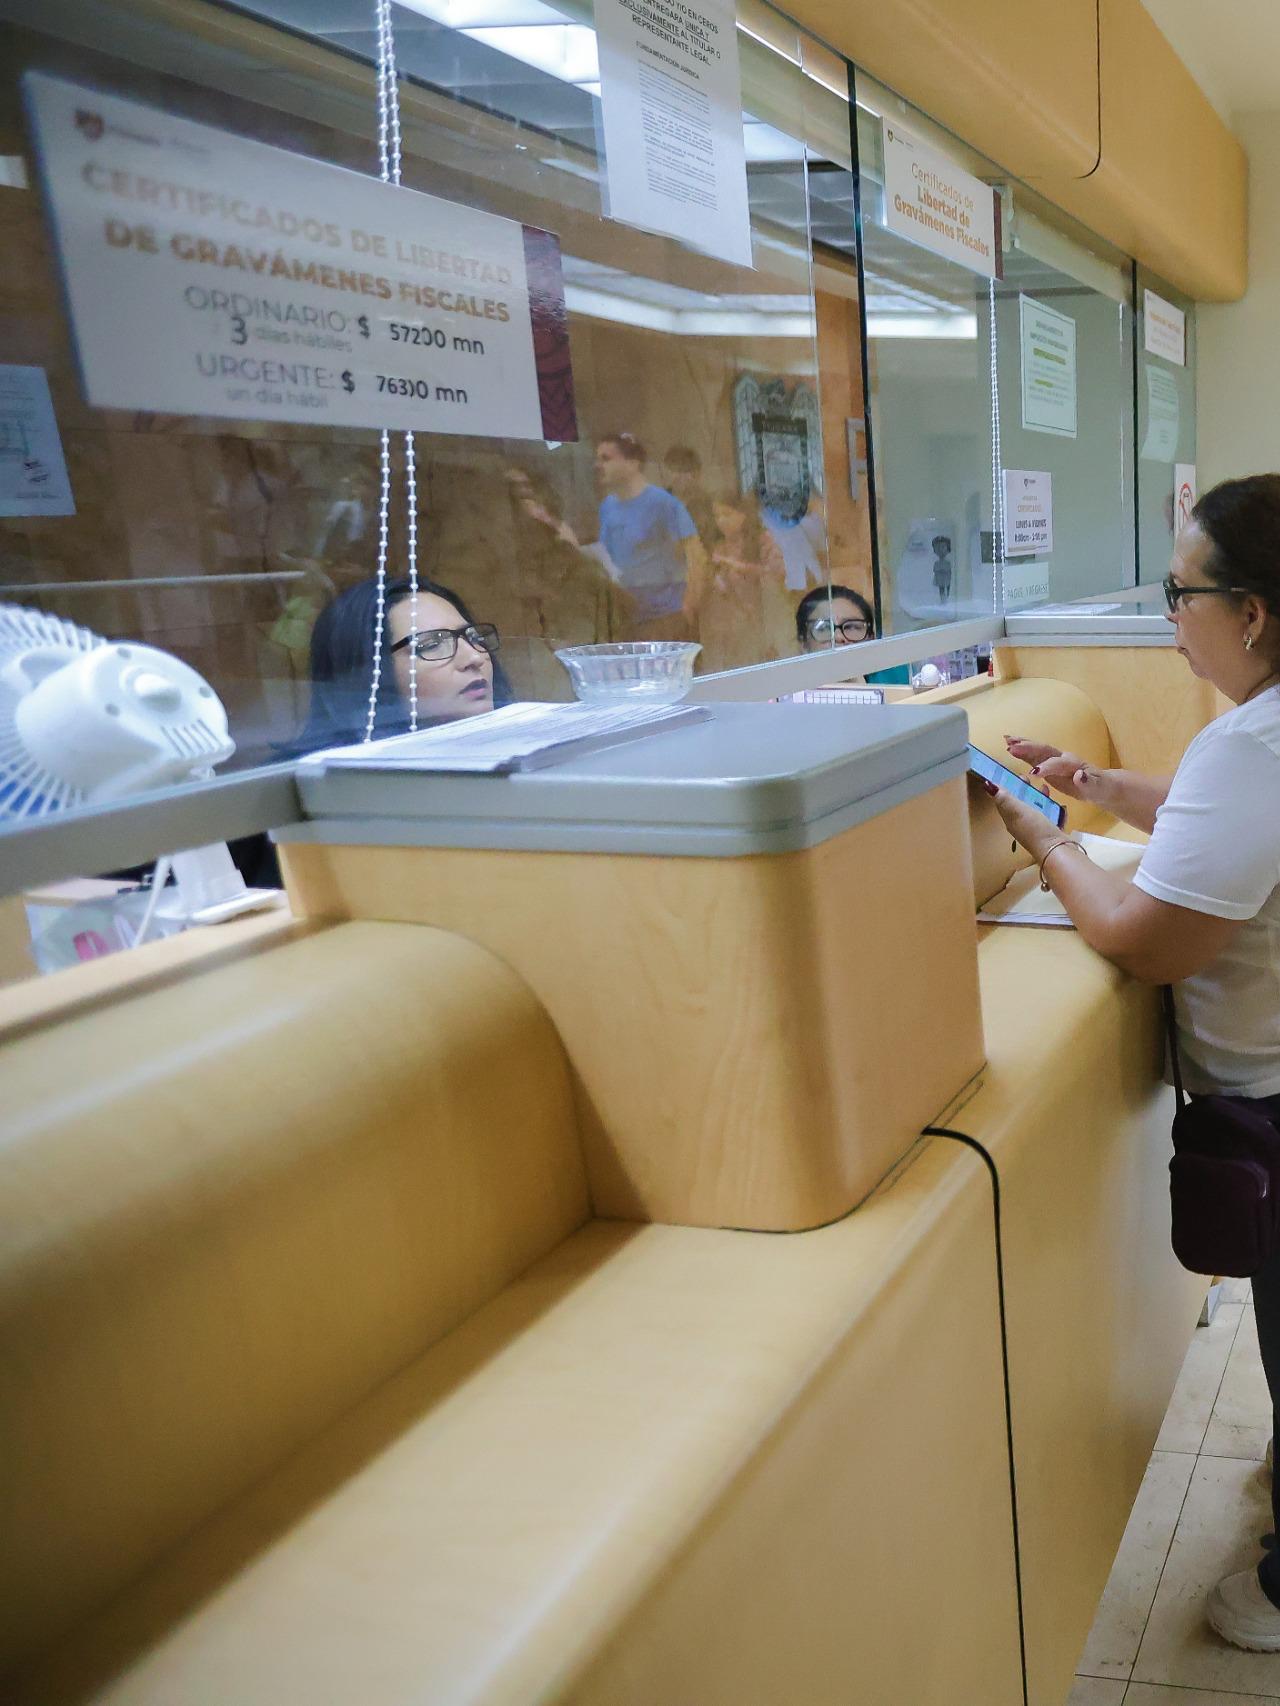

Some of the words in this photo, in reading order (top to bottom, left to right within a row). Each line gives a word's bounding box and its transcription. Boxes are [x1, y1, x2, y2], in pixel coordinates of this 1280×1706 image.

[632, 14, 689, 53] REPRESENTANTE
[698, 14, 718, 35] CEROS
[690, 34, 715, 55] TITULAR
[911, 162, 964, 206] Certificados
[965, 195, 976, 213] de
[918, 185, 958, 222] Libertad
[959, 209, 971, 229] de
[80, 160, 342, 248] CERTIFICADOS
[351, 229, 388, 258] DE
[396, 240, 513, 285] LIBERTAD
[894, 193, 955, 240] Gravámenes
[956, 228, 990, 257] Fiscales
[105, 217, 158, 255] DE
[171, 232, 393, 300] GRAVÁMENES
[399, 281, 510, 323] FISCALES
[230, 315, 248, 346] 3
[453, 335, 485, 355] mn
[341, 368, 356, 394] $
[436, 386, 468, 404] mn
